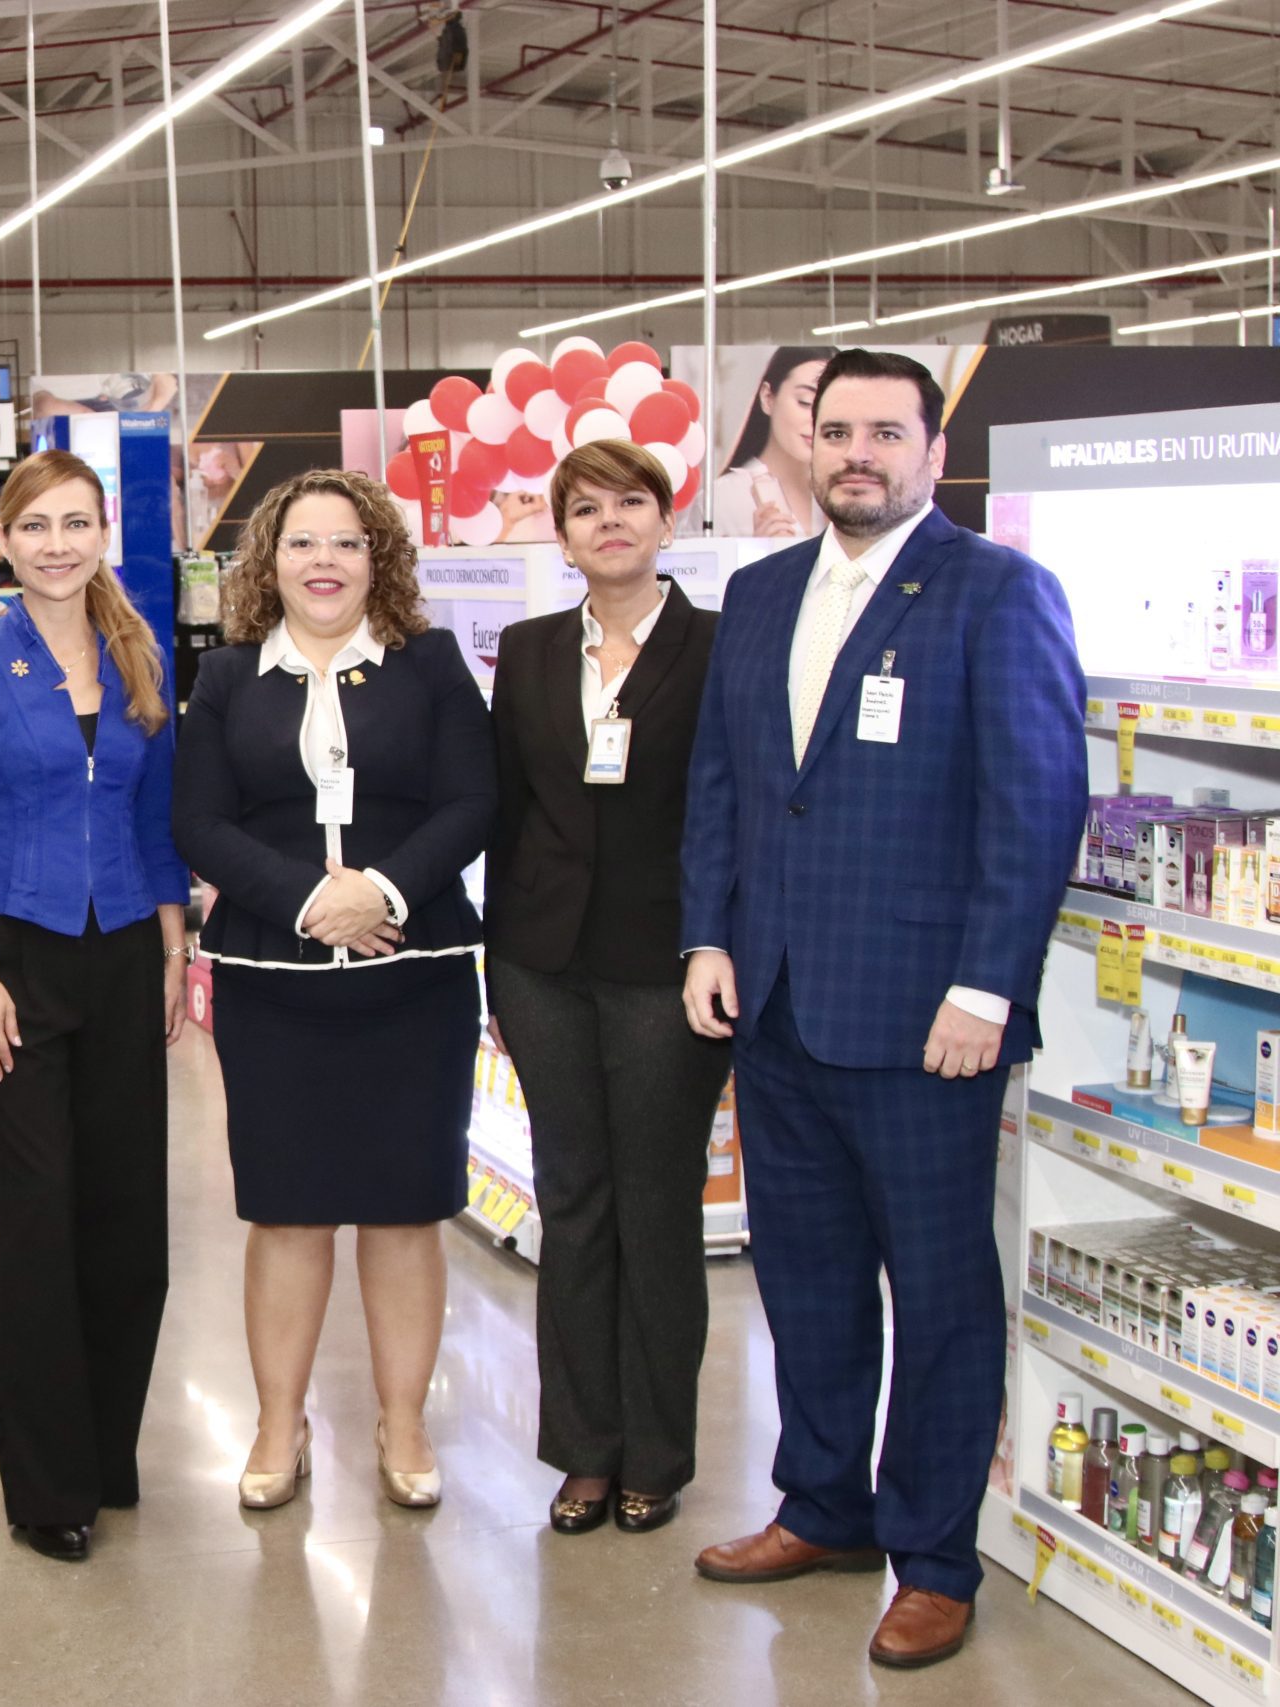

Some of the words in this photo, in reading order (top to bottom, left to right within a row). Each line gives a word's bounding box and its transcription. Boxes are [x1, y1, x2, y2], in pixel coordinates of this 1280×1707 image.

[998, 323, 1044, 347] HOGAR
[1050, 438, 1158, 468] INFALTABLES
[1161, 437, 1186, 463] EN
[1190, 435, 1214, 460] TU
[426, 568, 455, 583] PRODUCTO
[455, 568, 510, 585] DERMOCOSMÉTICO
[472, 621, 501, 650] Euceri
[1130, 683, 1161, 697] SERUM
[1126, 906, 1157, 922] SERUM
[1128, 1126, 1141, 1141] UV
[1104, 1542, 1144, 1577] MICELAR
